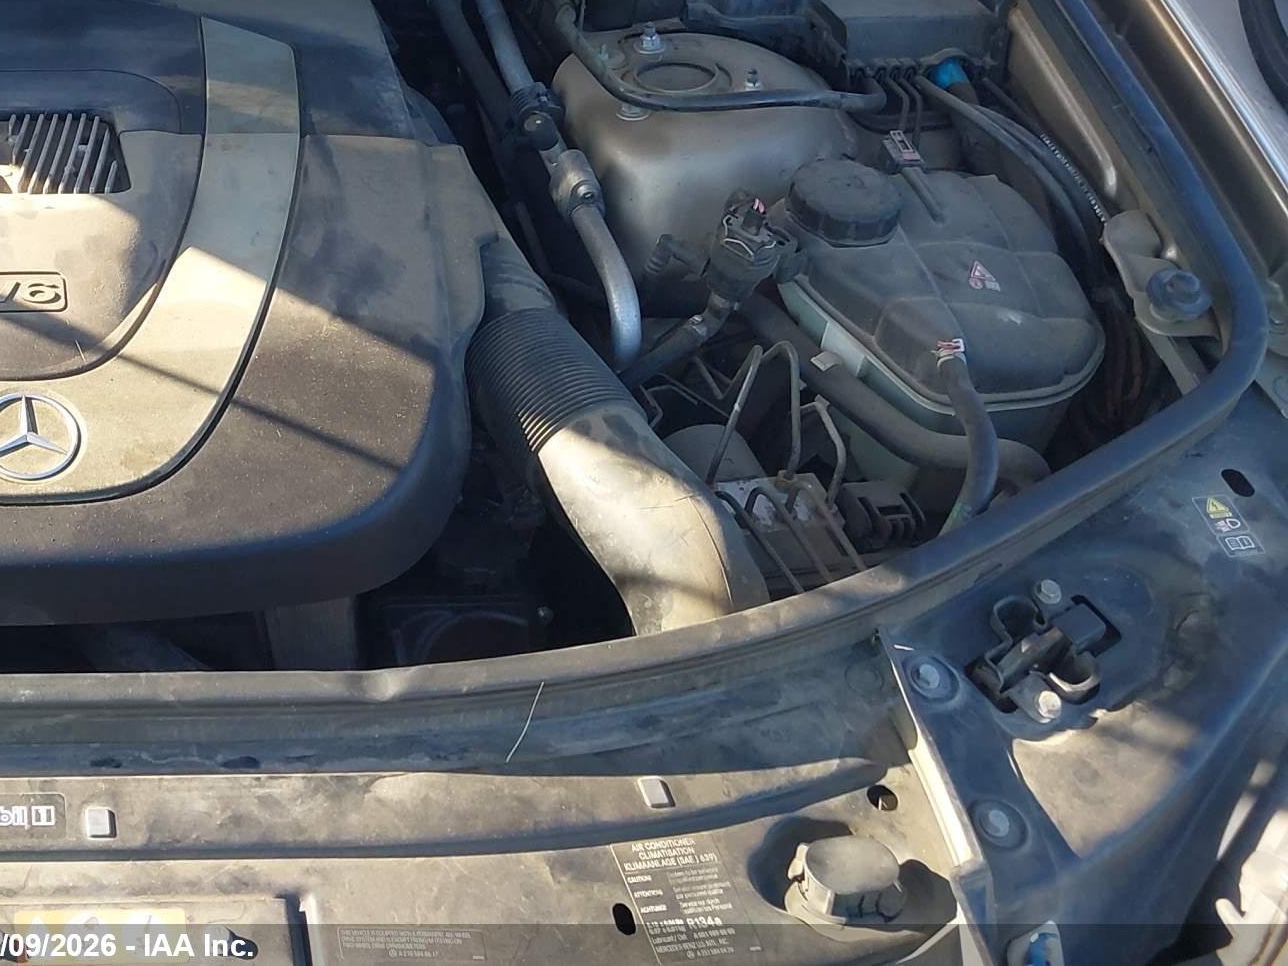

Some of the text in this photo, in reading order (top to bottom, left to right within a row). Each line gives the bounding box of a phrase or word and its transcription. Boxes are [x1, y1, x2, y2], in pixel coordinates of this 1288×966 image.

[632, 843, 645, 853] AIR
[623, 857, 677, 871] KLIMAANLAGE
[686, 916, 723, 930] R134a
